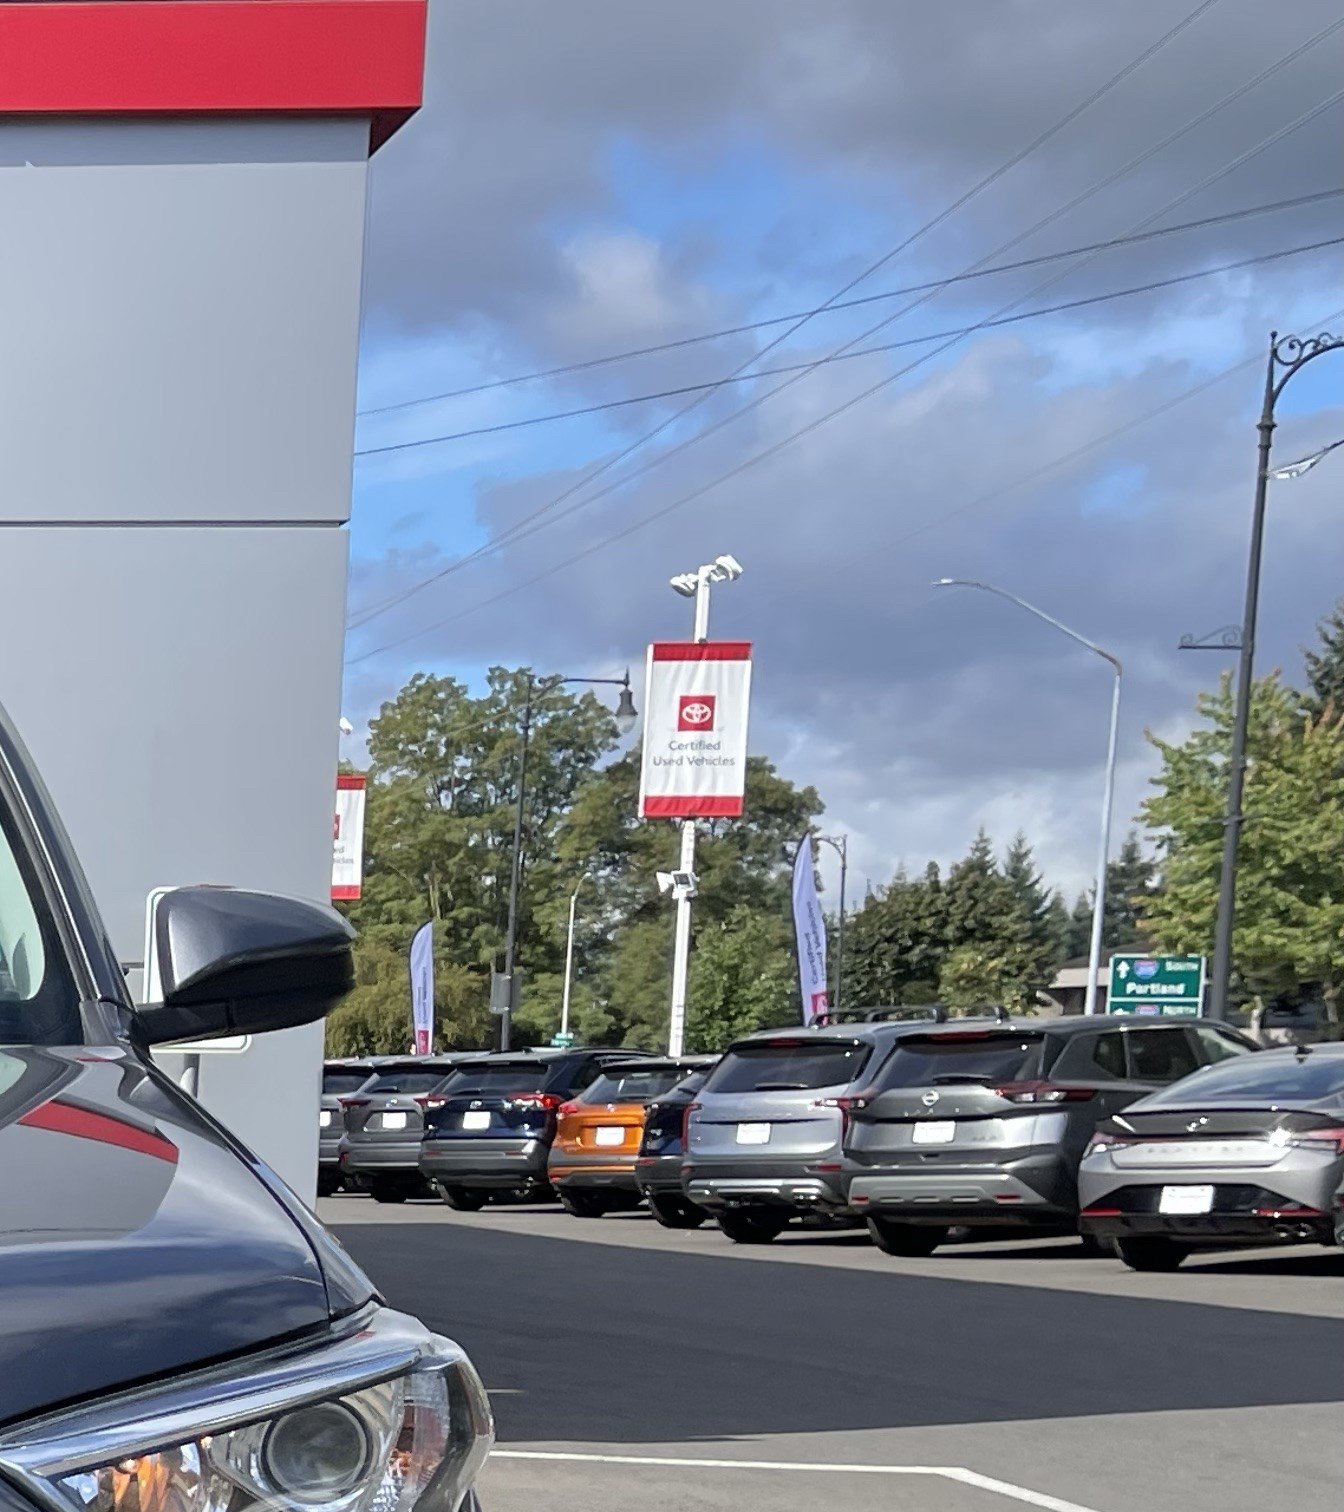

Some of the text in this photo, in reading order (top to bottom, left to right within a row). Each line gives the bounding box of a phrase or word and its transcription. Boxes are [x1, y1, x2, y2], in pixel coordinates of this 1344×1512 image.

[668, 740, 722, 751] Certified
[653, 755, 735, 767] Used Vehicles
